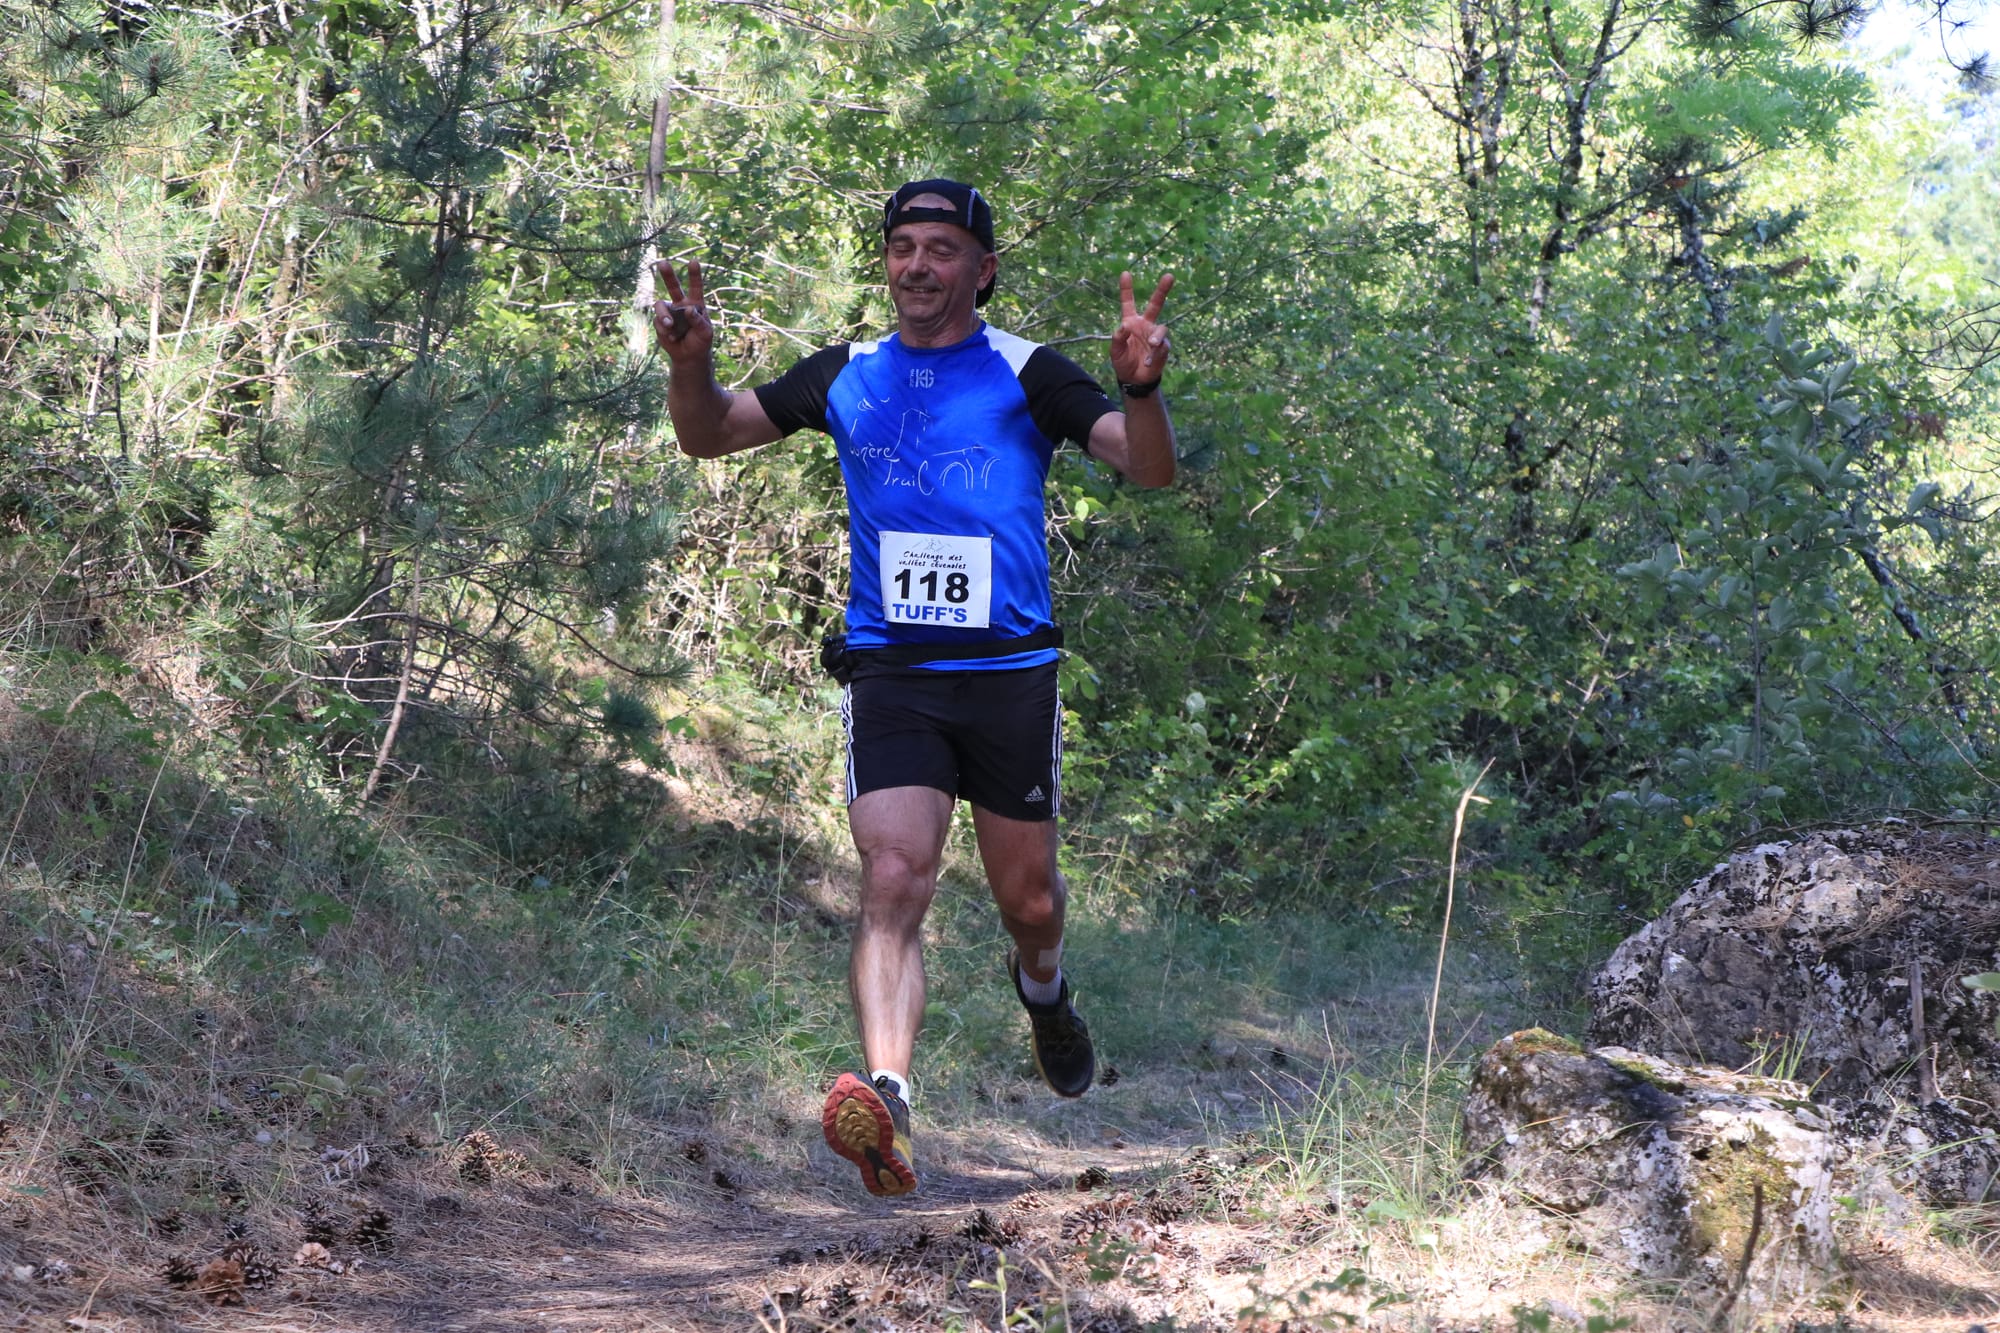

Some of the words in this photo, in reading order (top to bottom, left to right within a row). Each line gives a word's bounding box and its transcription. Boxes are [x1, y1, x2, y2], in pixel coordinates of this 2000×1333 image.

[904, 551, 944, 561] Challenge
[894, 568, 969, 604] 118
[893, 603, 967, 623] TUFF'S
